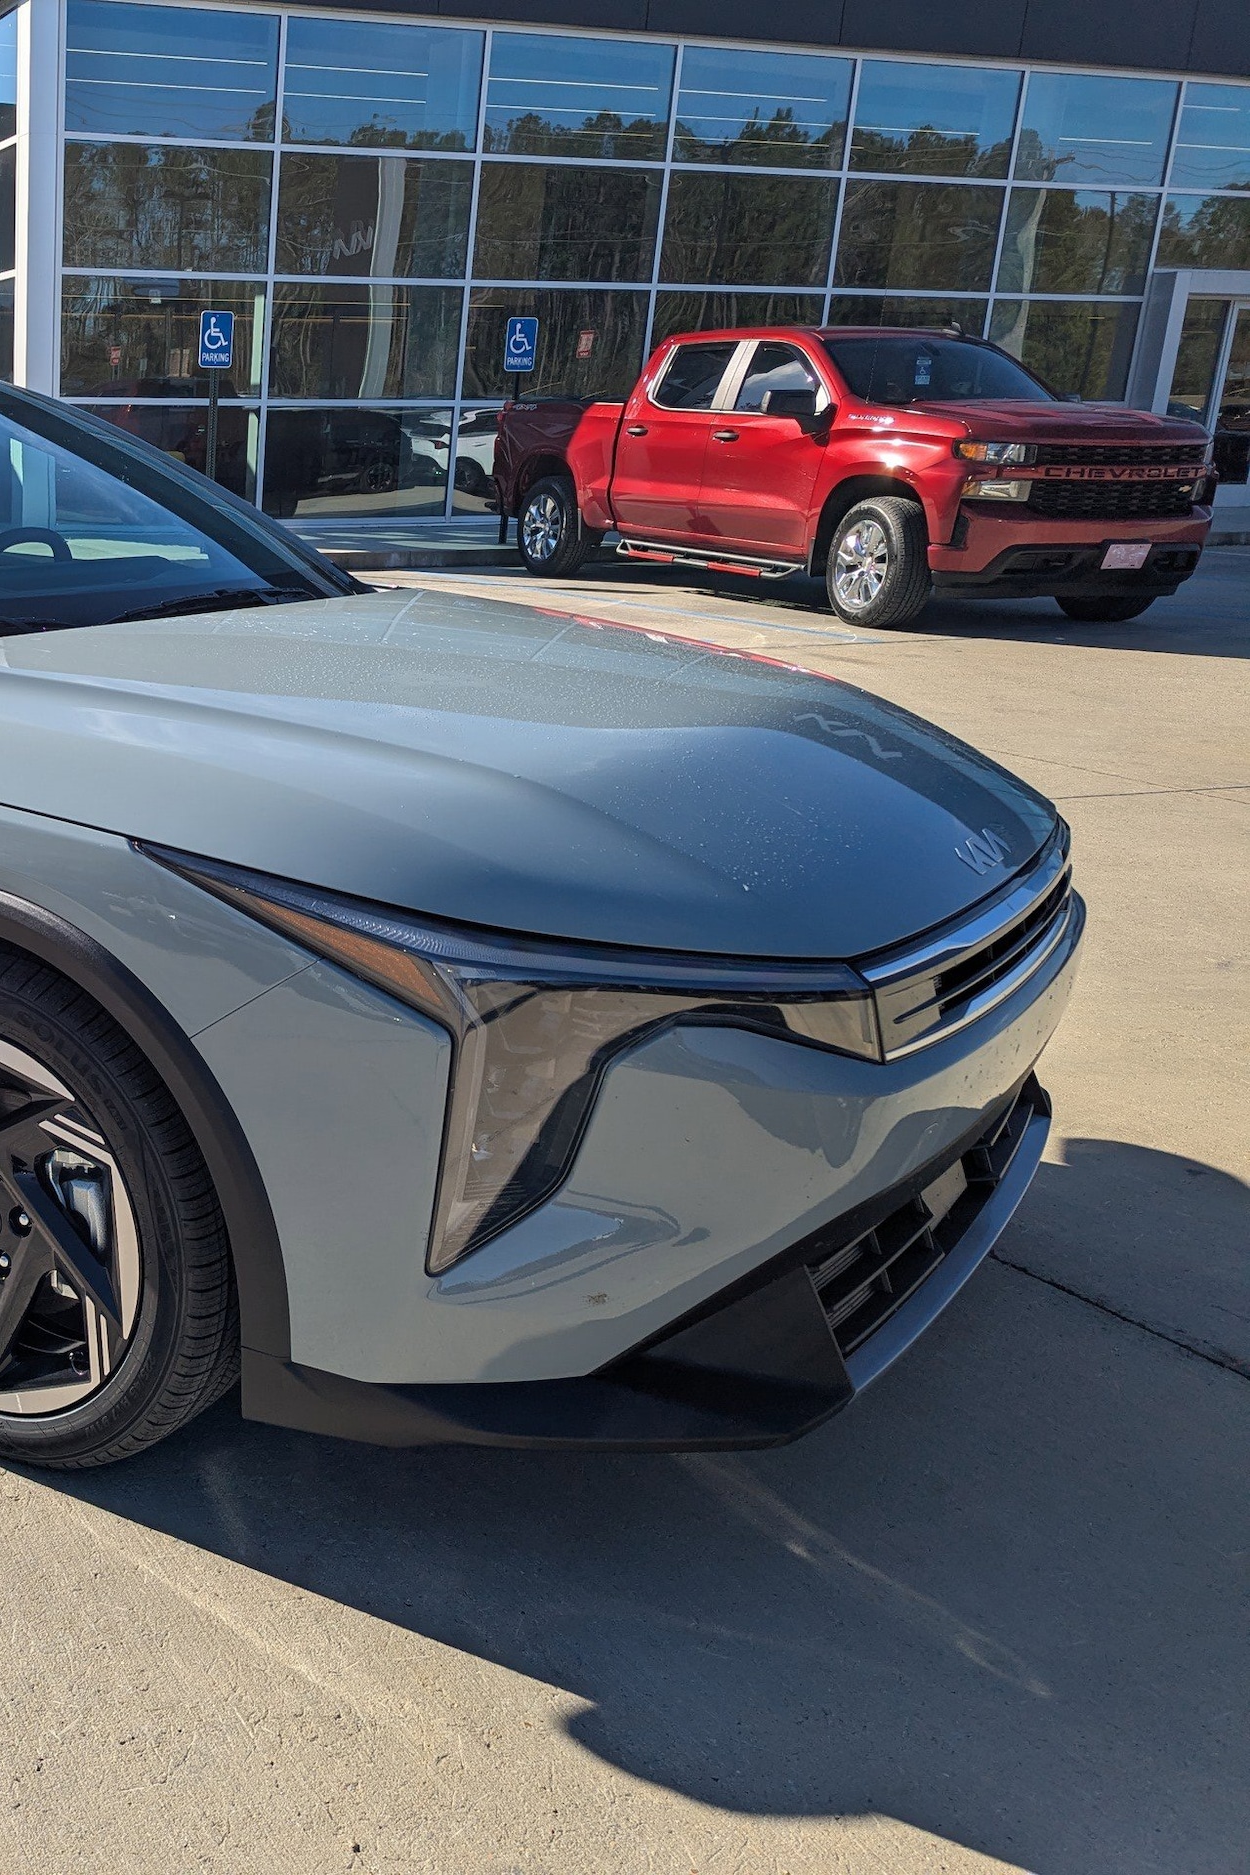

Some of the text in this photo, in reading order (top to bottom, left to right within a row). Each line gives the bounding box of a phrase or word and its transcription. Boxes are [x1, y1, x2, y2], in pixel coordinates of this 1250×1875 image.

[202, 352, 230, 363] PARKING
[507, 356, 532, 366] PARKING
[1044, 467, 1203, 478] CHEVROLET
[12, 1007, 108, 1098] SOLUS
